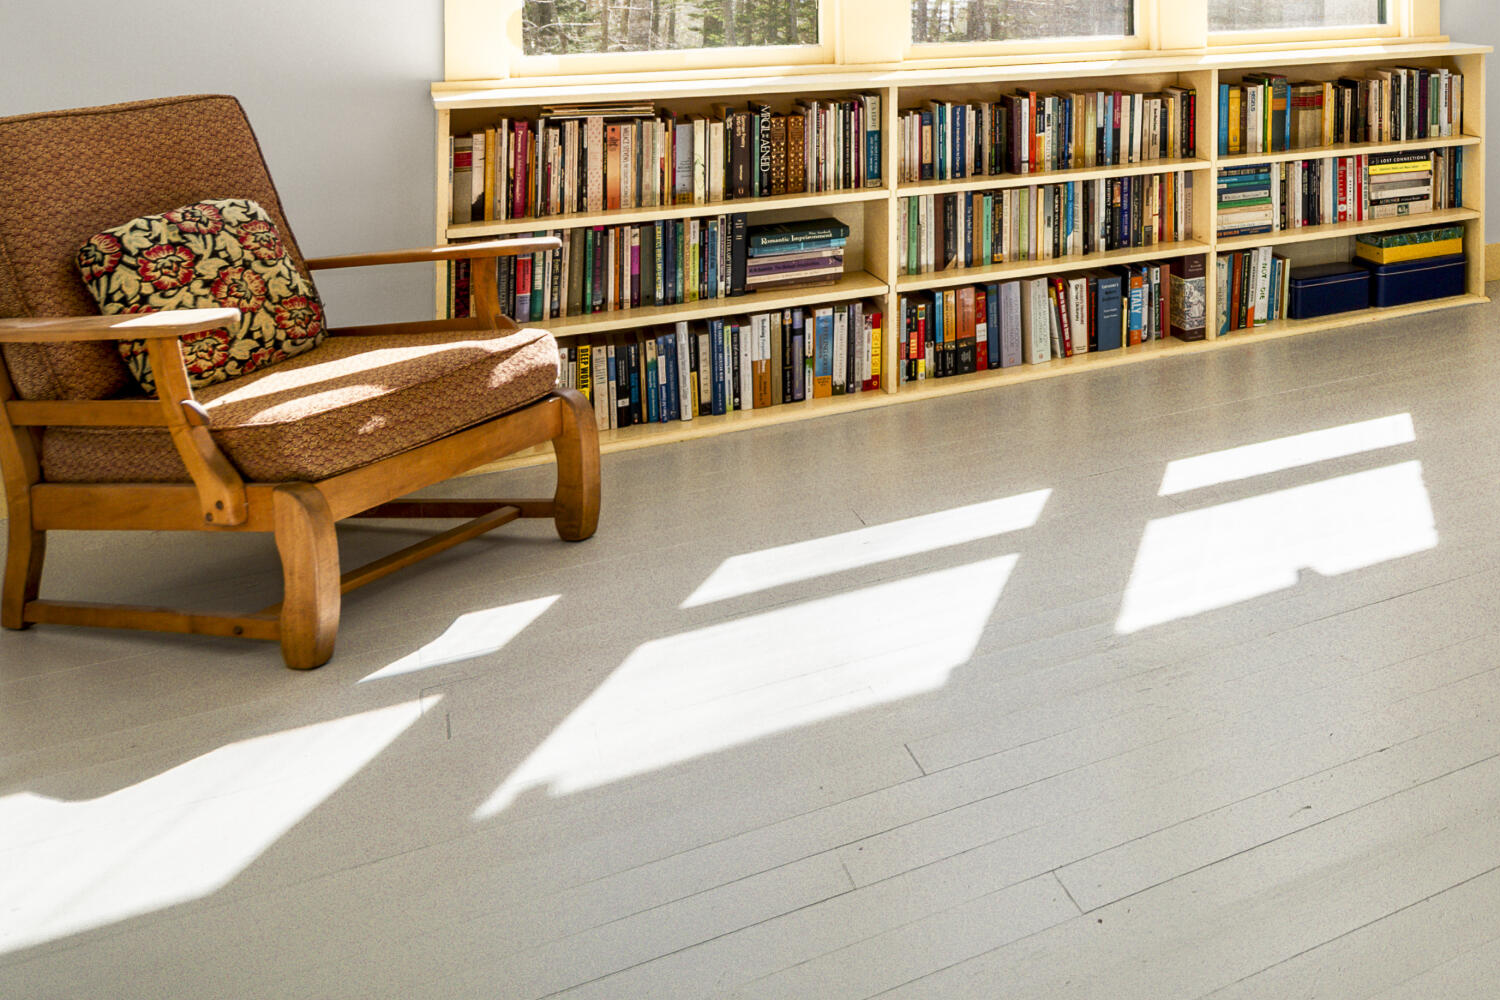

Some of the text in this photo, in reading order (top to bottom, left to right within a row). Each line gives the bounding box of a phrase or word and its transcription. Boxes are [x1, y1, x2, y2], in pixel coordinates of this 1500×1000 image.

[761, 233, 833, 245] Romantic Imprisonment
[1131, 289, 1142, 314] ITALY
[580, 348, 589, 390] DEEP WORK
